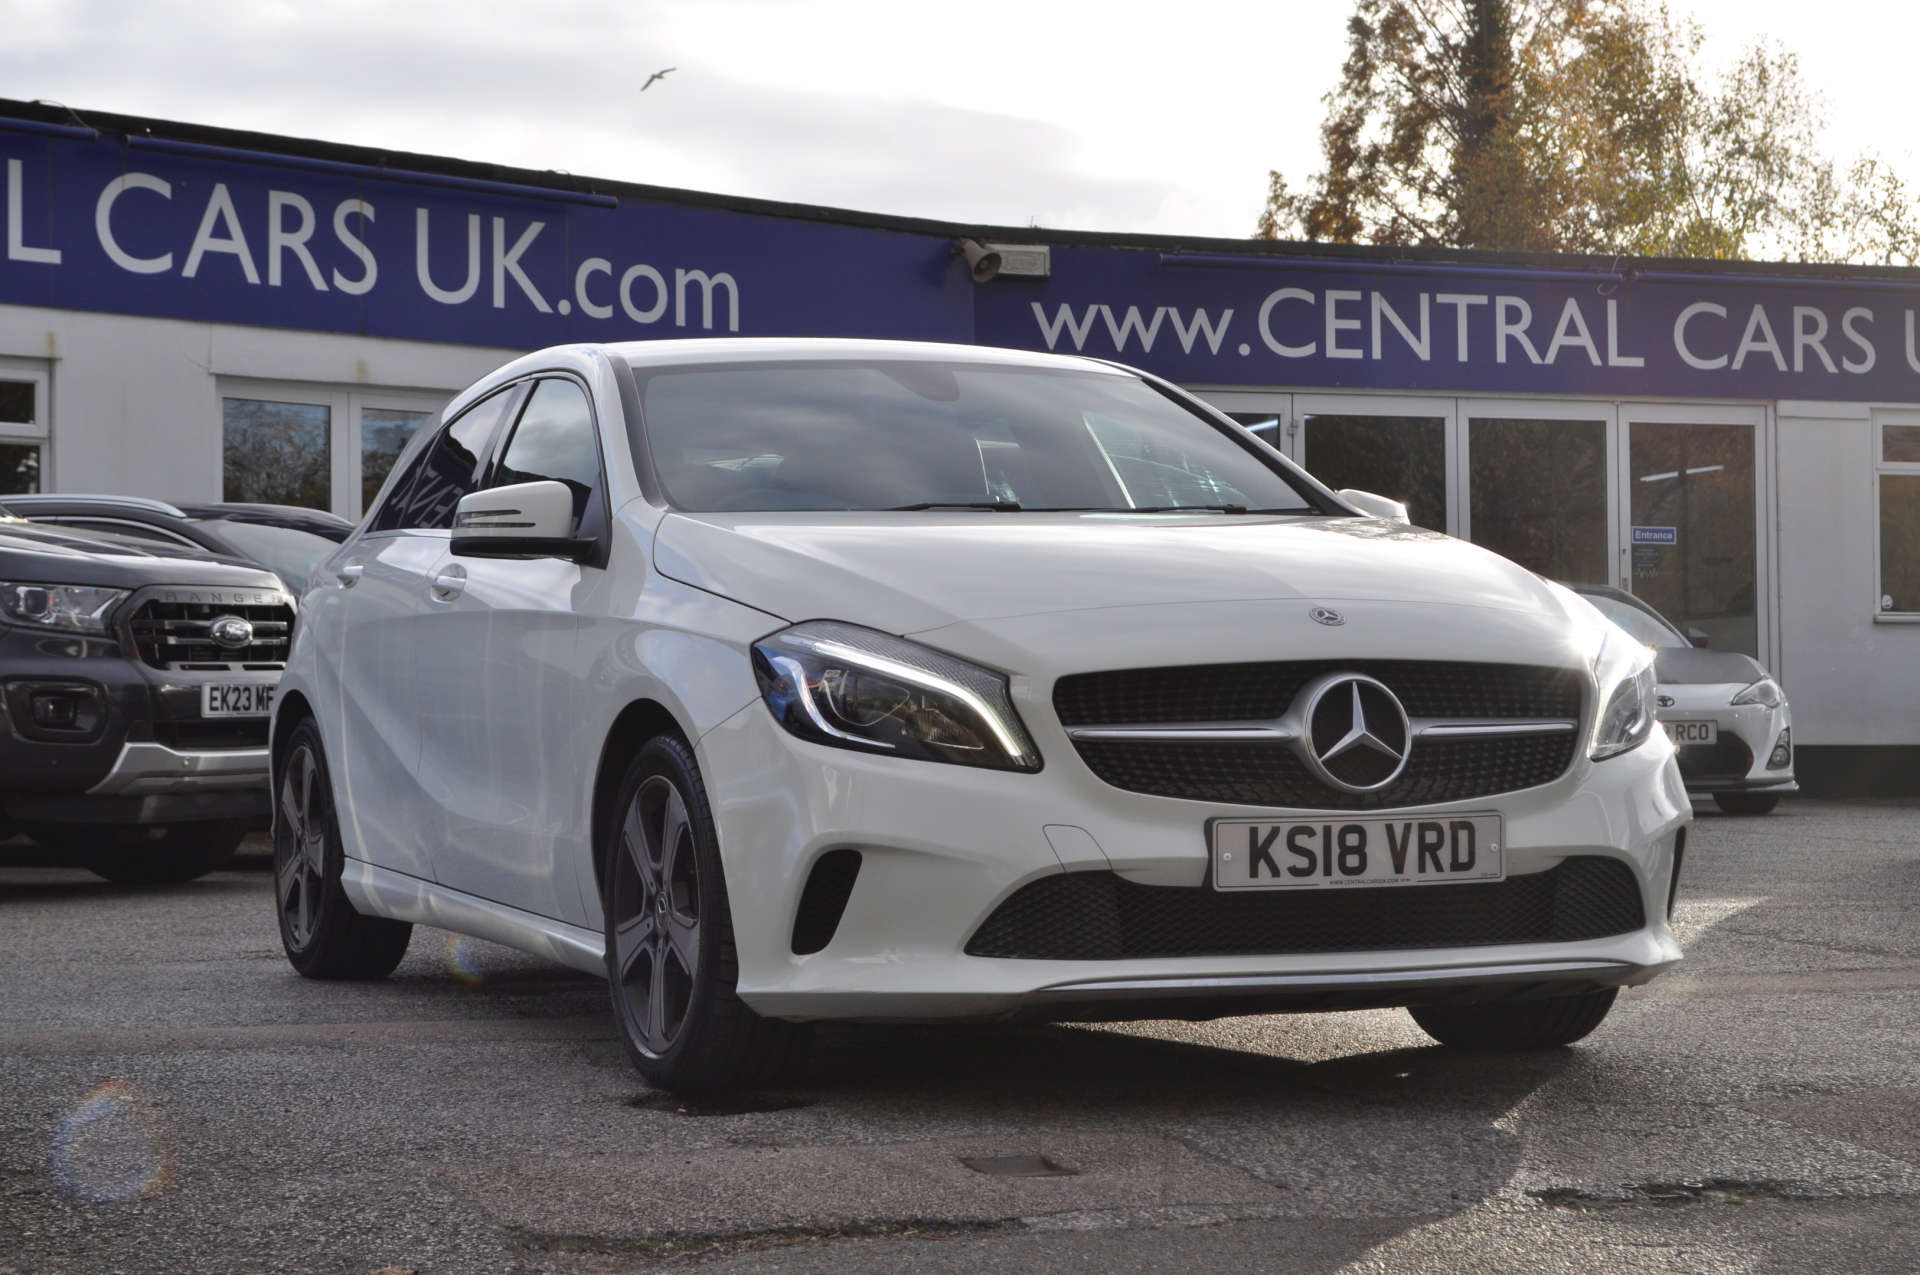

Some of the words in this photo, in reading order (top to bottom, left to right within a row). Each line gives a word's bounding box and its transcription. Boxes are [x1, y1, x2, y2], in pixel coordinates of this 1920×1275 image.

[96, 172, 379, 295] CARS
[416, 208, 740, 333] UK.com
[1030, 287, 1645, 368] www.CENTRAL
[1673, 301, 1877, 374] CARS
[210, 686, 252, 711] EK23
[1249, 825, 1368, 879] KS18
[1384, 820, 1476, 875] VRD
